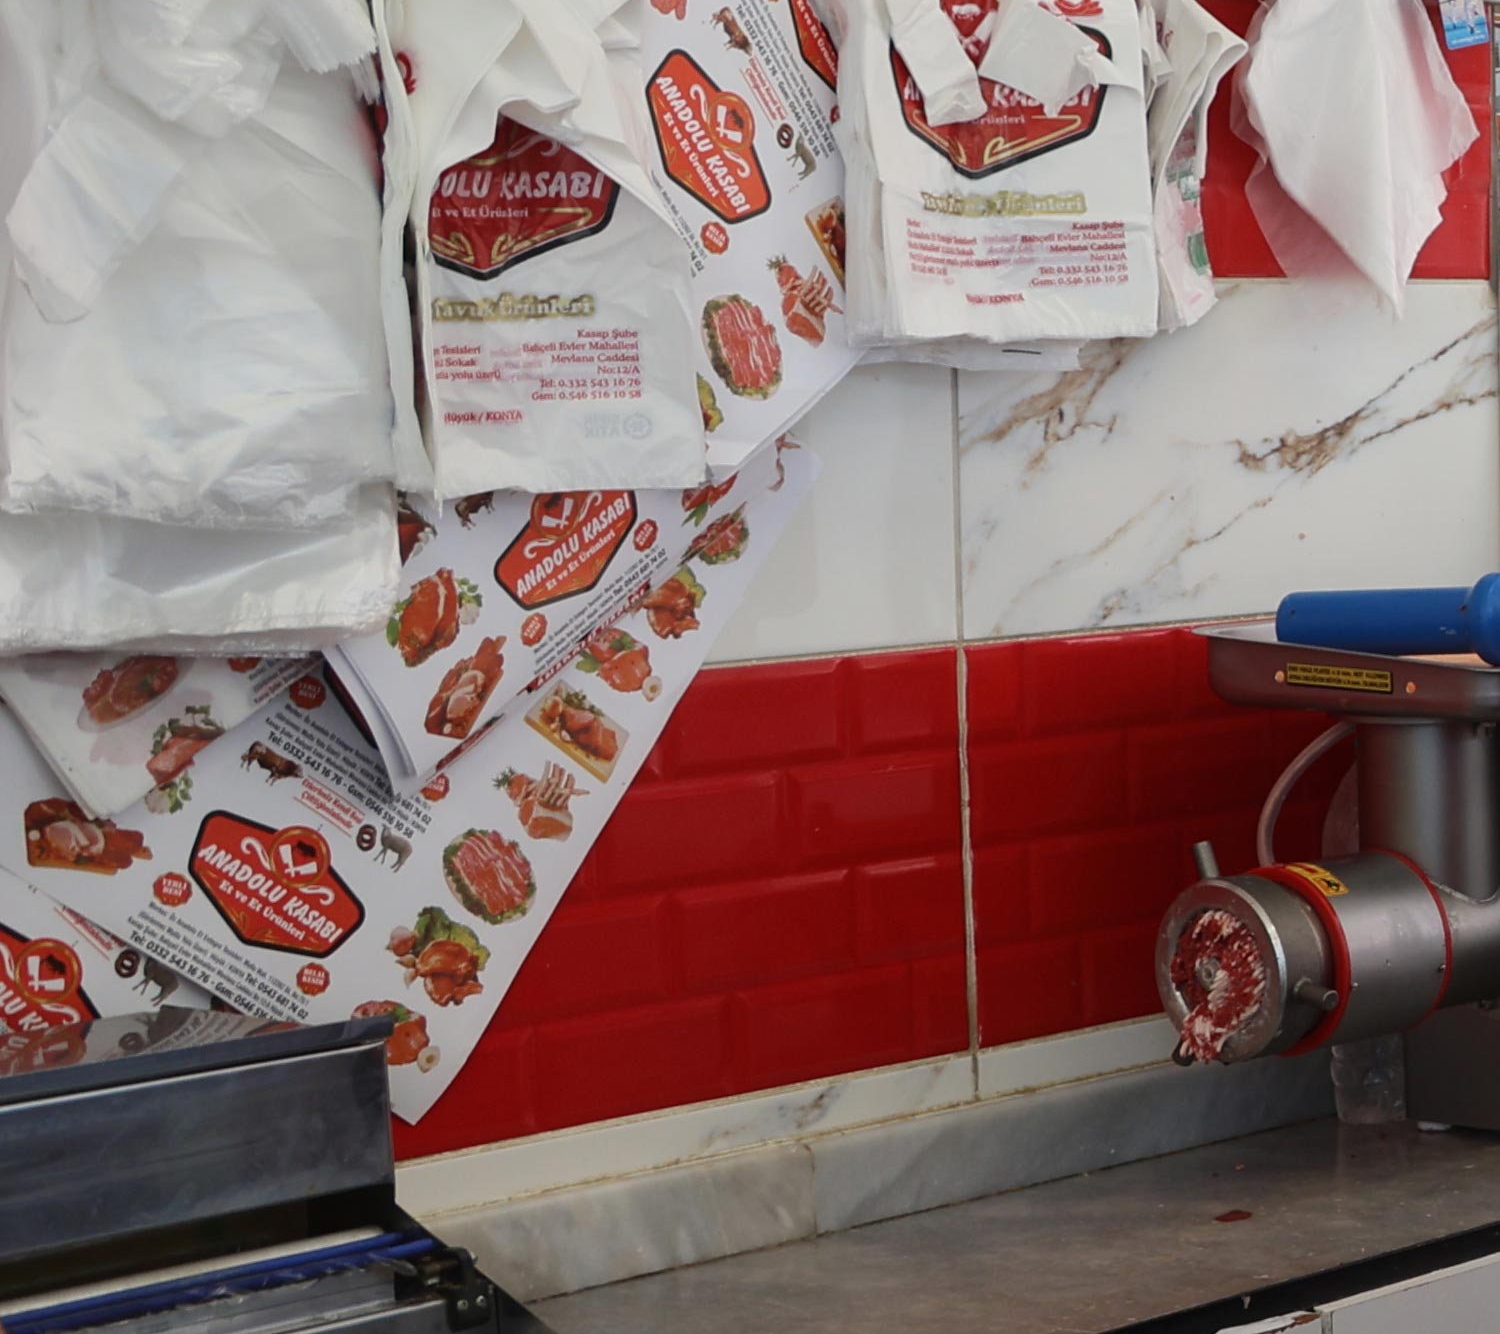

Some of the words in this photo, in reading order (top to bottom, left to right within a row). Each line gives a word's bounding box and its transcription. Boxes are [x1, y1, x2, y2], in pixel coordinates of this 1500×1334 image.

[655, 75, 713, 153] ANADOLU
[705, 151, 752, 215] KASABI
[515, 534, 580, 599] ANADOLU
[582, 491, 632, 544] KASABI
[197, 843, 288, 905] ANADOLU
[282, 892, 344, 945] KASABI
